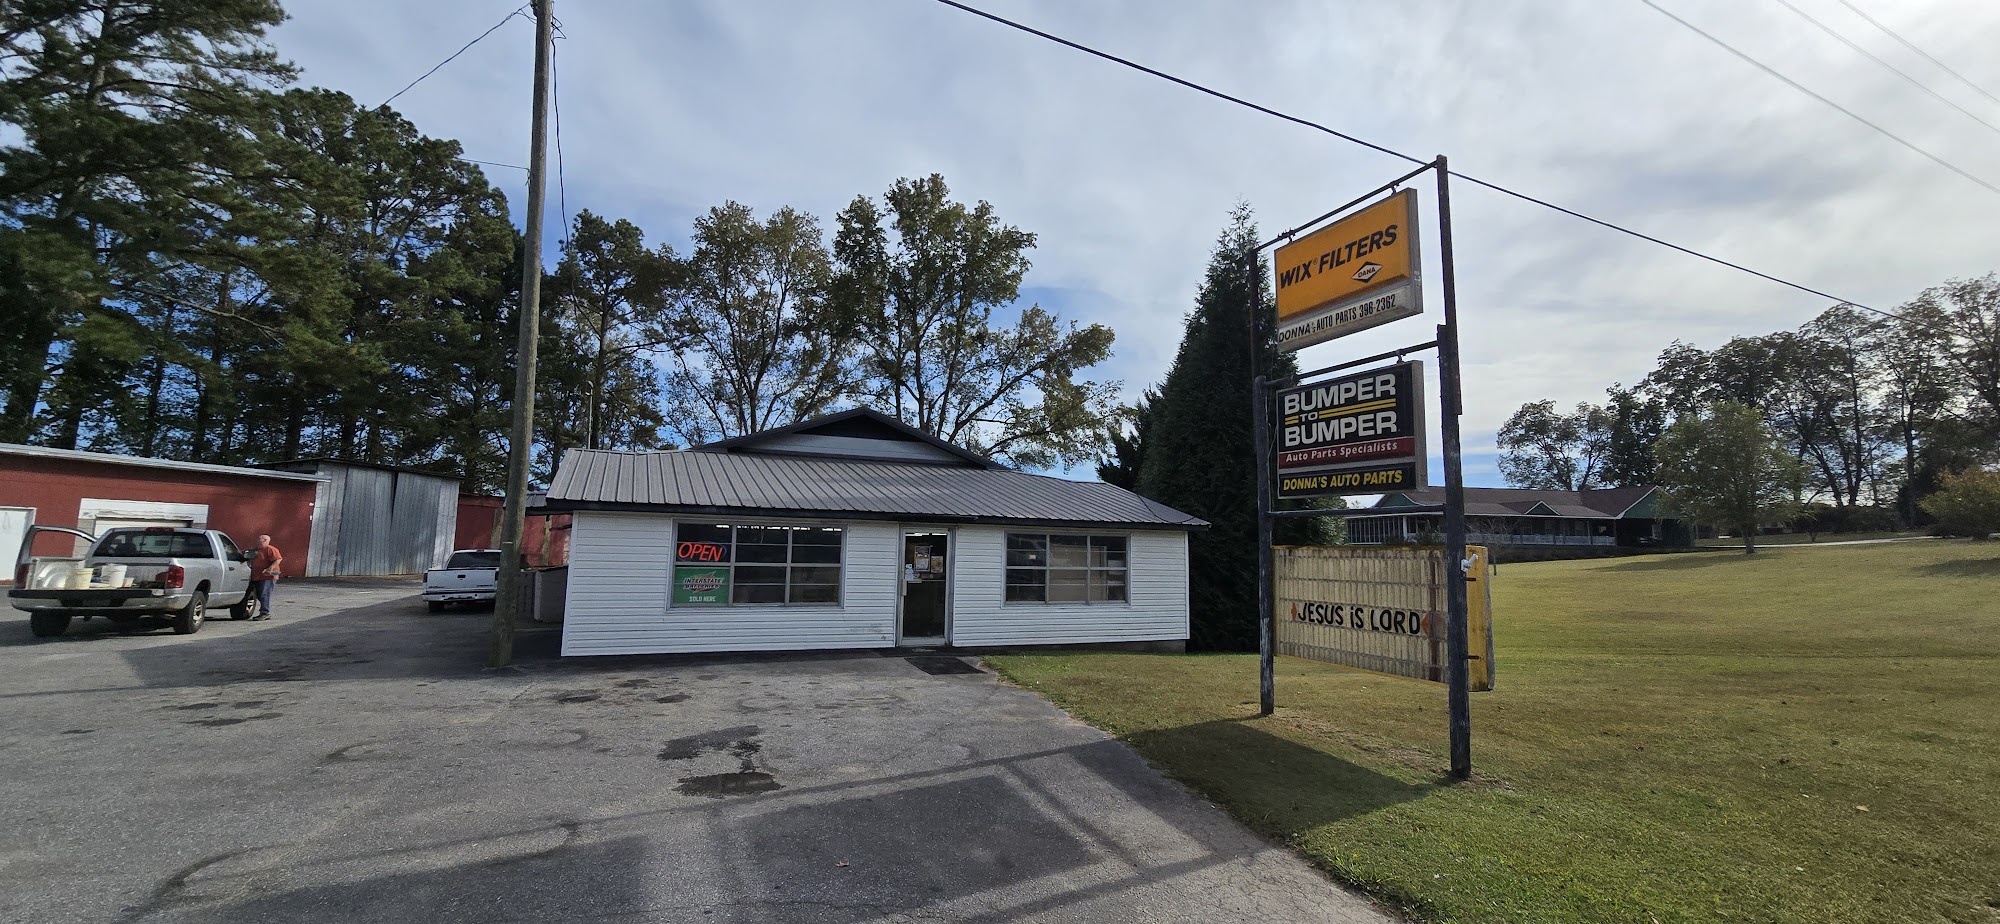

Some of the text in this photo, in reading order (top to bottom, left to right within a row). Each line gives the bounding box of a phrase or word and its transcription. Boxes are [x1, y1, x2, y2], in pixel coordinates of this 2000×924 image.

[1318, 224, 1398, 274] FILTERS
[1357, 266, 1376, 278] DANA
[1316, 314, 1333, 331] AUTO
[1335, 306, 1357, 325] PARTS
[1359, 293, 1396, 318] 396-2362
[1284, 373, 1397, 416] BUMPER
[1284, 410, 1397, 447] BUMPER
[1300, 411, 1319, 423] TO
[1285, 440, 1398, 463] Auto Parts Specialists
[1283, 469, 1402, 491] DONNA'S AUTO PARTS
[678, 541, 724, 562] OPEN
[1298, 601, 1344, 626] JESUS
[1370, 609, 1421, 635] LORD
